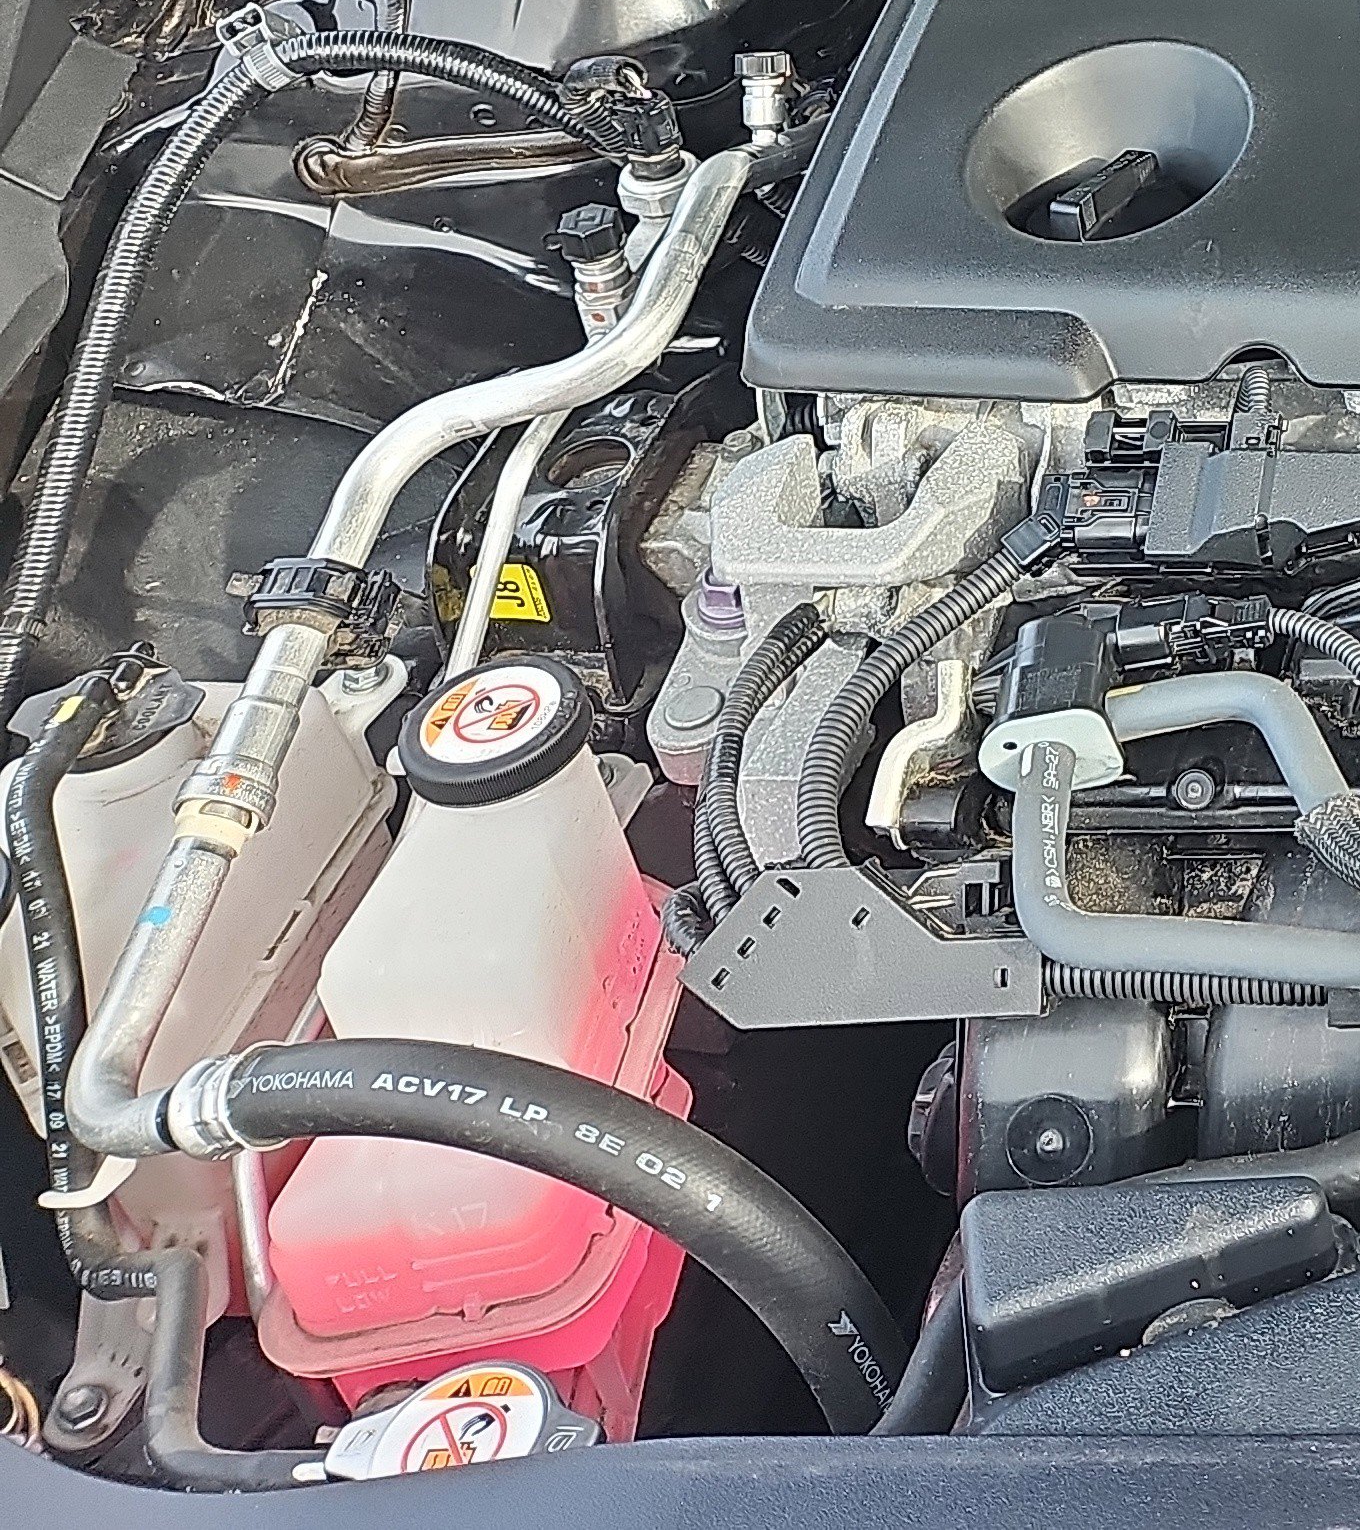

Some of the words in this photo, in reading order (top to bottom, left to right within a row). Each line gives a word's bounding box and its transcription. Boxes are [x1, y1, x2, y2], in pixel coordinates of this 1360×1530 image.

[131, 683, 174, 731] COOLANT
[37, 956, 60, 1013] WATER
[250, 1070, 355, 1094] YOKOHAMA
[370, 1073, 488, 1105] ACV17
[499, 1096, 548, 1121] LP
[49, 1111, 66, 1130] 09
[51, 1142, 69, 1158] 21
